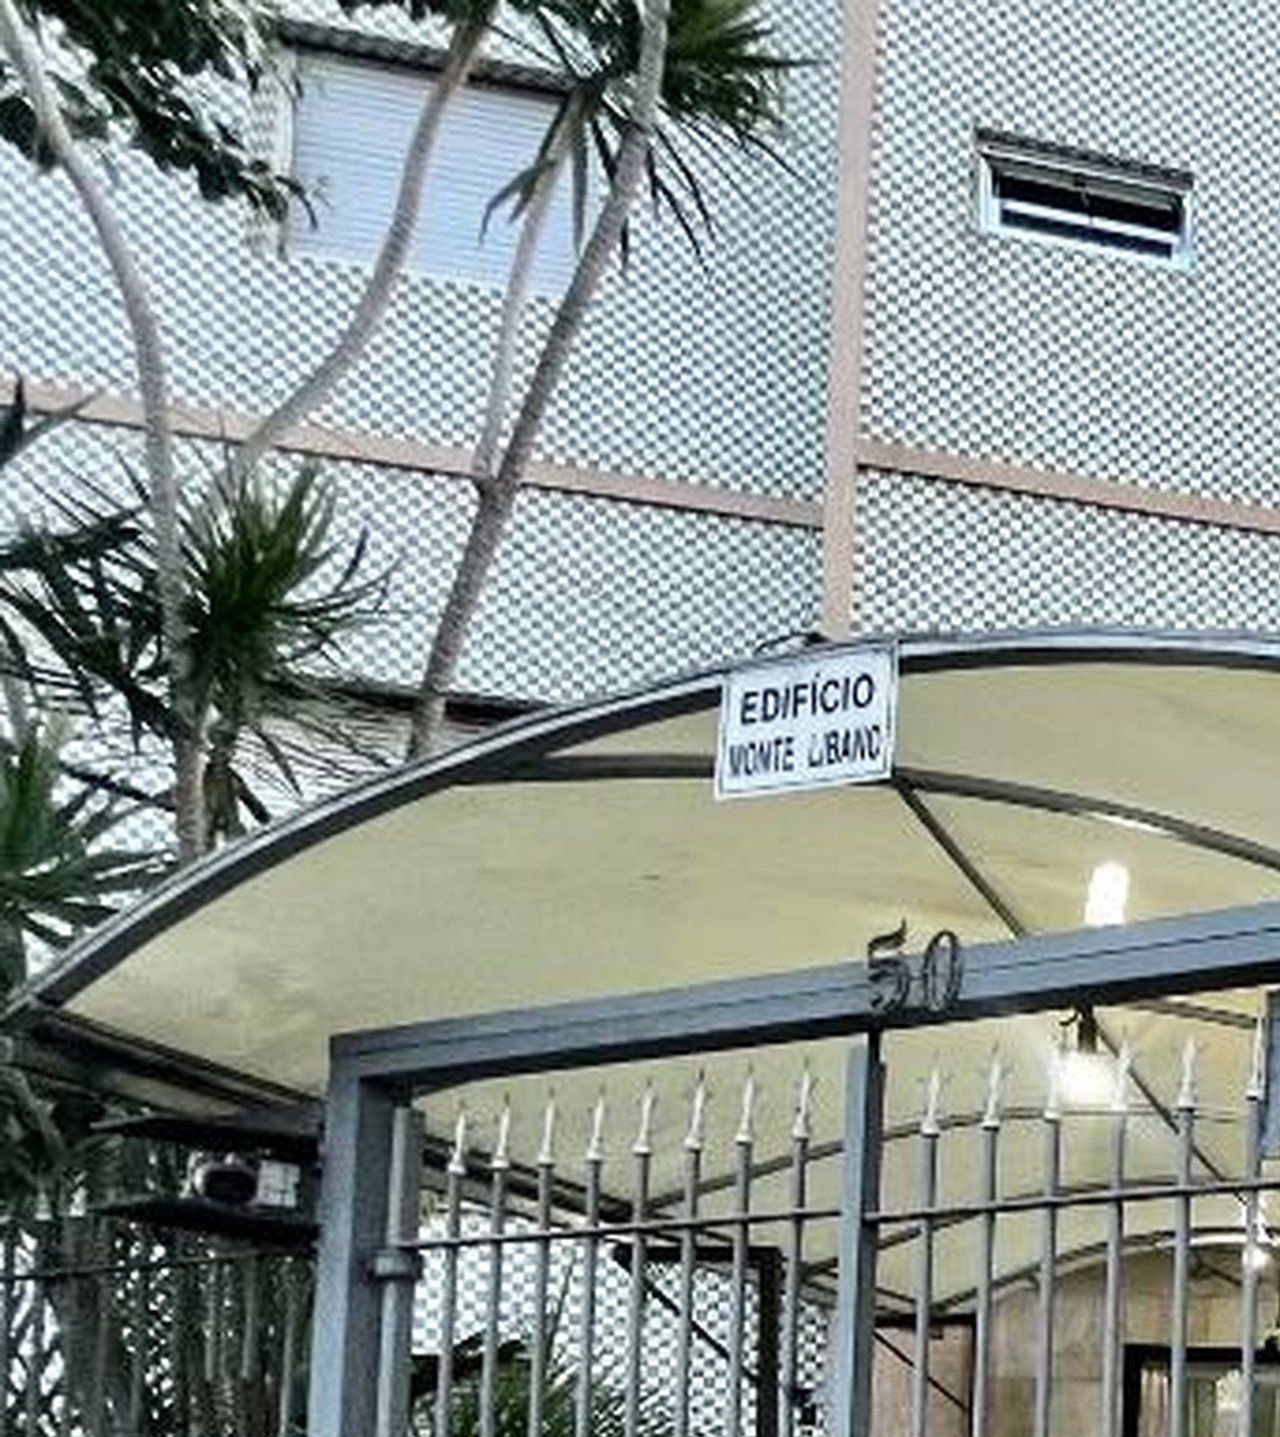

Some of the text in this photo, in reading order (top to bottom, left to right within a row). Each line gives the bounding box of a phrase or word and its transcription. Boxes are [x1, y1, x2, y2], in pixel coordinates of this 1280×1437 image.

[740, 672, 875, 725] EDIFÍCIO
[729, 737, 794, 776] MONTE
[867, 917, 963, 1017] 50
